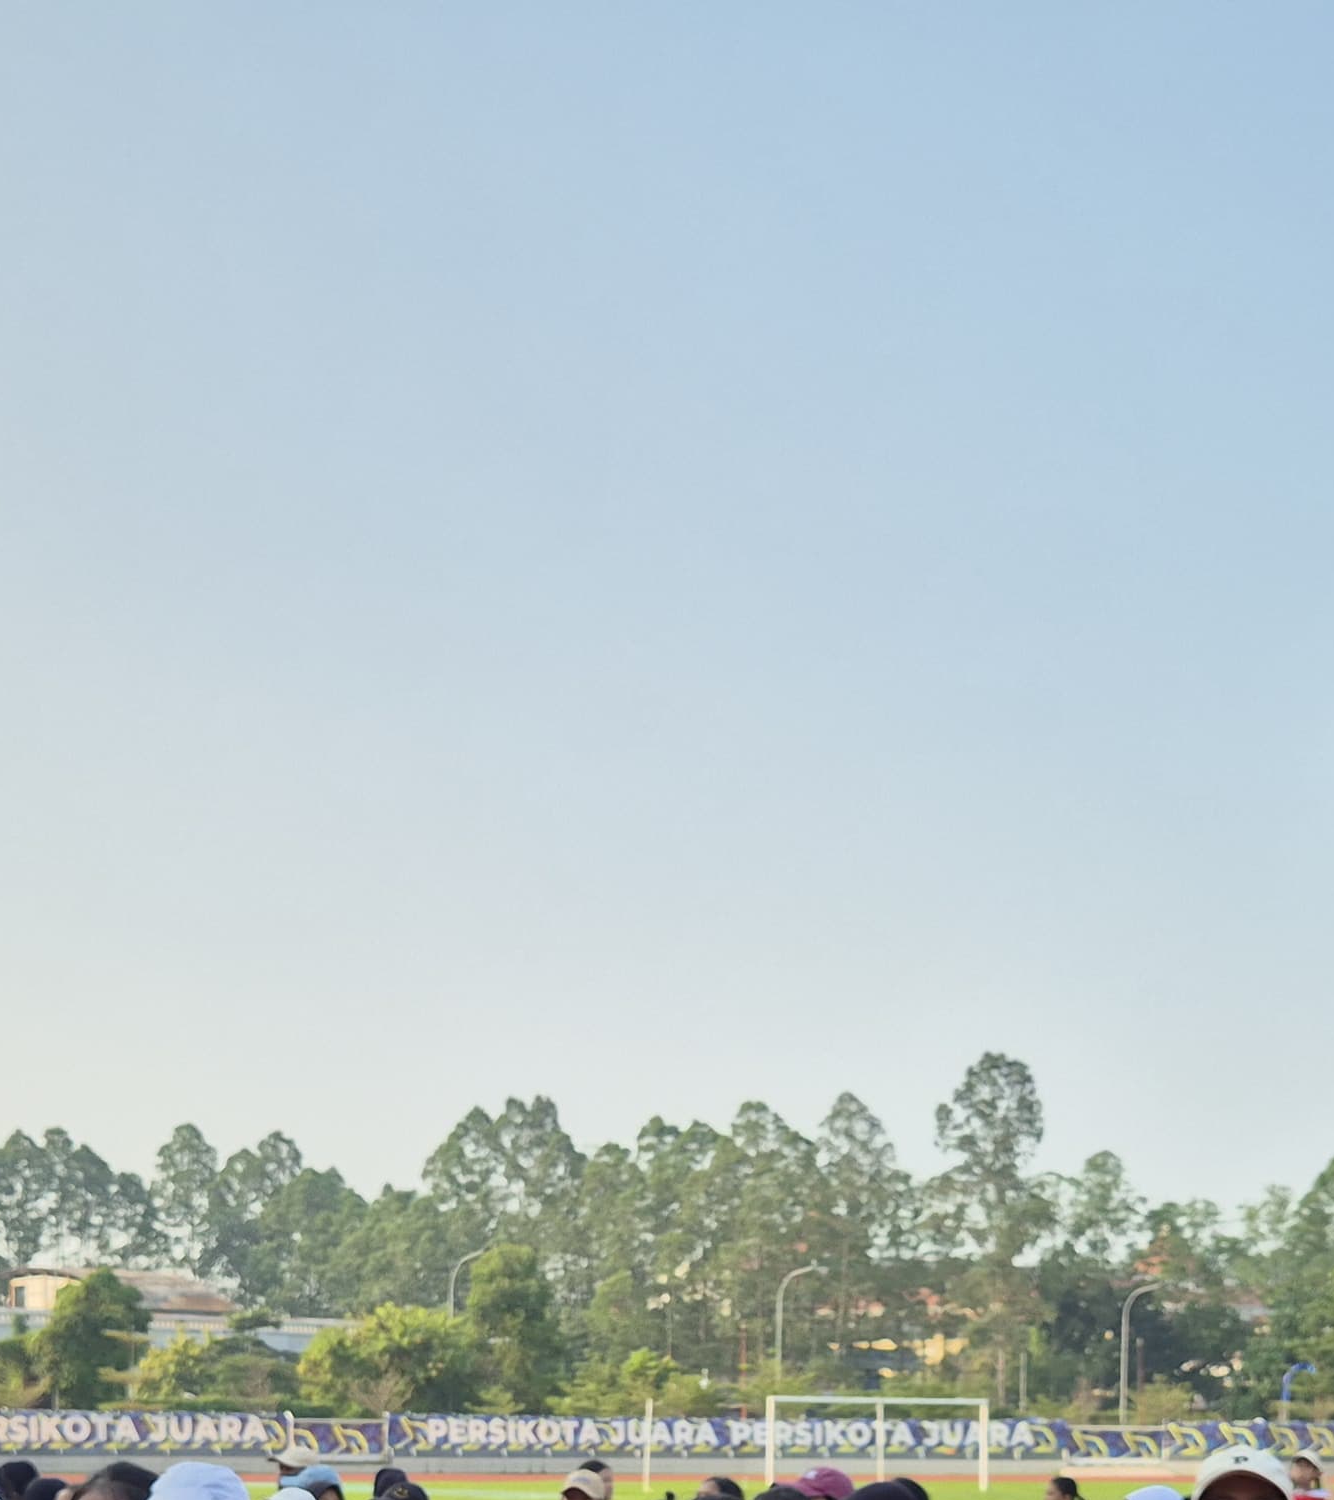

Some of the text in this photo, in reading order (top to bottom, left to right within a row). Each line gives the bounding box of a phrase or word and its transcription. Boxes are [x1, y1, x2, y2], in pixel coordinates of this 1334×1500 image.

[149, 1413, 269, 1443] JUARA
[426, 1417, 1037, 1448] PERSIKOTA JUARA PERSIKOTA JUARA
